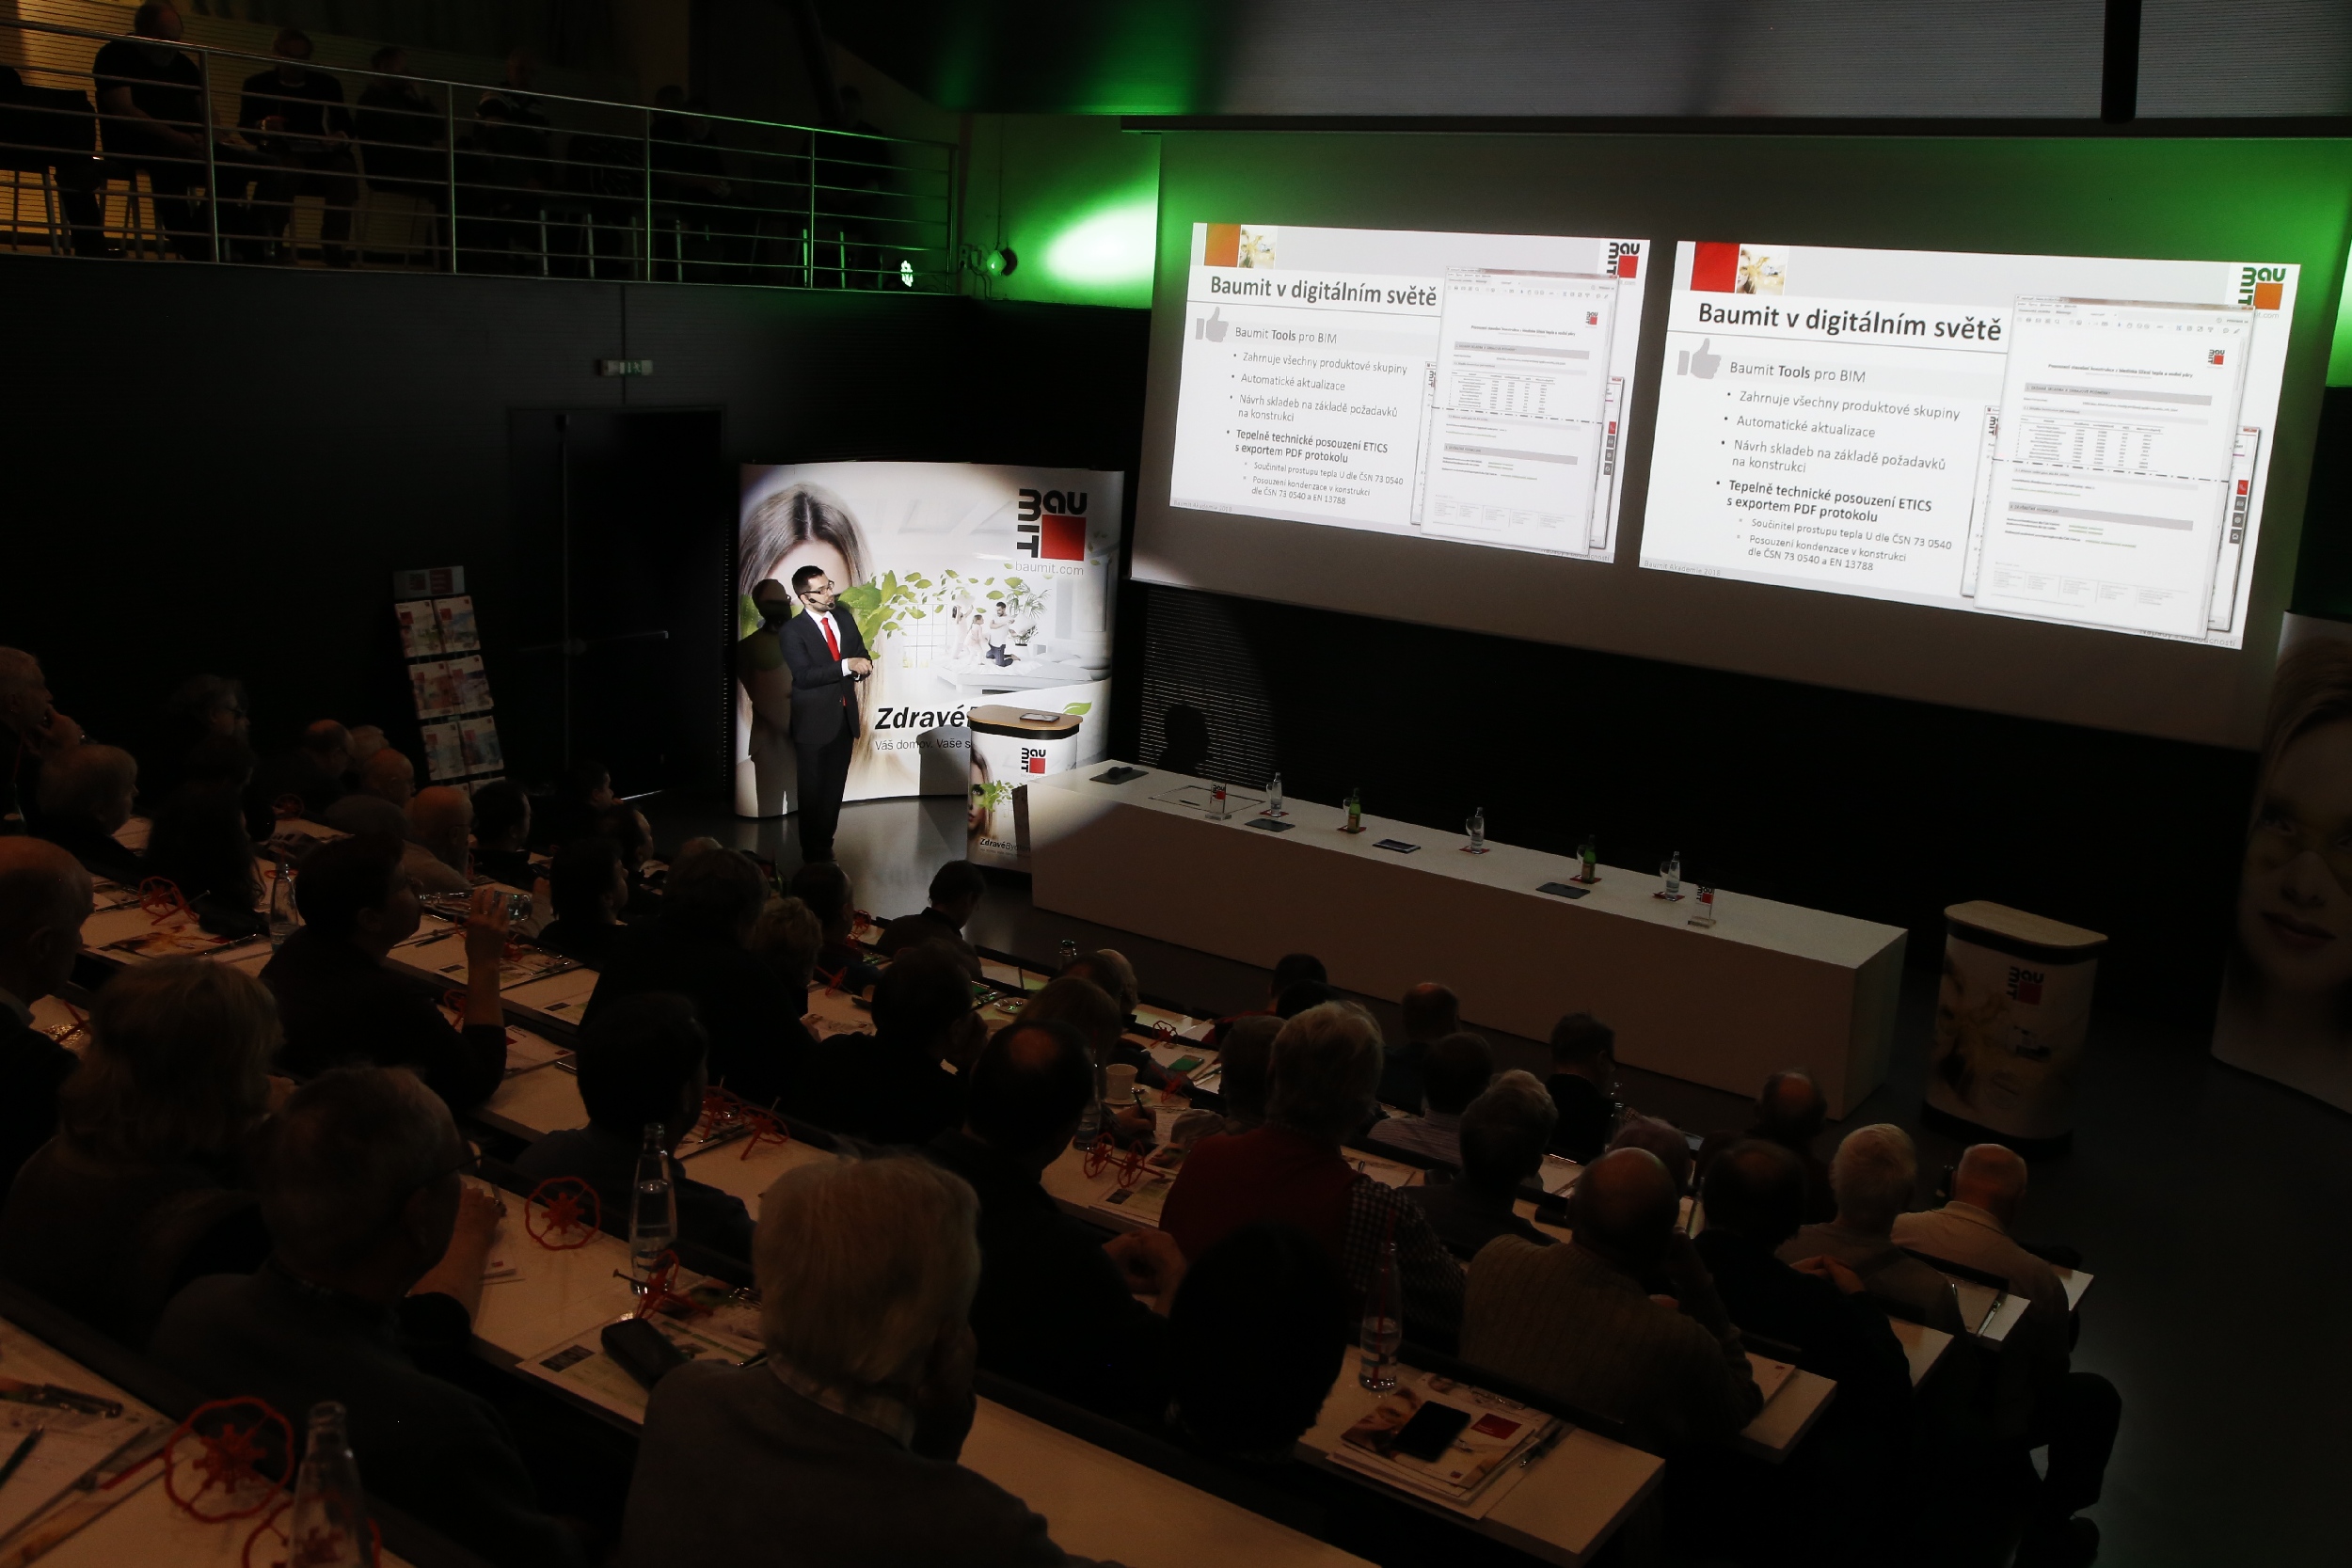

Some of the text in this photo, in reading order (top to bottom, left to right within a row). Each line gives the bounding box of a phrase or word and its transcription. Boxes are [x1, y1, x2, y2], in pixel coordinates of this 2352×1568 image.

[1211, 276, 1437, 307] Baumit v digitálním světě
[1698, 303, 2002, 341] Baumit v digitálním světě
[1235, 326, 1337, 344] Baumit Tools pro BIM
[1243, 352, 1407, 375] Zahrnuje všechny produktové skupiny
[1730, 362, 1867, 383] Baumit Tools pro BIM
[1241, 373, 1345, 390] Automatické aktualizace
[1238, 409, 1295, 422] na konstrukci
[1240, 394, 1398, 418] Návrh skladeb na základě požadavků
[1740, 390, 1961, 421] Zahrnuje všechny produktové skupiny
[1737, 415, 1875, 438] Automatické aktualizace
[1236, 429, 1389, 453] Tepelně technické posouzení ETICS
[1234, 444, 1349, 464] s exportem PDF protokolu
[1732, 456, 1806, 473] na konstrukci
[1734, 439, 1947, 470] Návrh skladeb na základě požadavků
[1254, 461, 1404, 485] Součinitel prostupu tepla U dle ČSN 73 0540
[1251, 486, 1263, 496] dle
[1263, 486, 1277, 497] ČSN
[1279, 489, 1287, 499] 73
[1289, 490, 1306, 500] 0540
[1312, 492, 1323, 502] EN
[1325, 494, 1346, 505] 13788
[1252, 476, 1286, 487] Posouzení
[1288, 478, 1327, 491] kondenzace
[1335, 483, 1371, 497] konstrukci
[1729, 480, 1931, 512] Tepelně technické posouzení ETICS
[1726, 498, 1878, 523] s exportem PDF protokolu
[1752, 517, 1952, 550] Součinitel prostupu tepla U dle ČSN 73 0540
[1748, 546, 1761, 558] dle
[1763, 546, 1781, 561] ČSN
[1784, 550, 1795, 562] 73
[1797, 551, 1820, 565] 0540
[1830, 555, 1842, 567] EN
[1845, 557, 1873, 571] 13788
[1749, 534, 1906, 562] Posouzení kondenzace v konstrukci
[1015, 561, 1084, 576] baumit.com
[875, 704, 977, 730] Zdravé
[875, 739, 894, 751] Váš
[896, 739, 933, 750] domov.
[936, 738, 962, 749] Vaše
